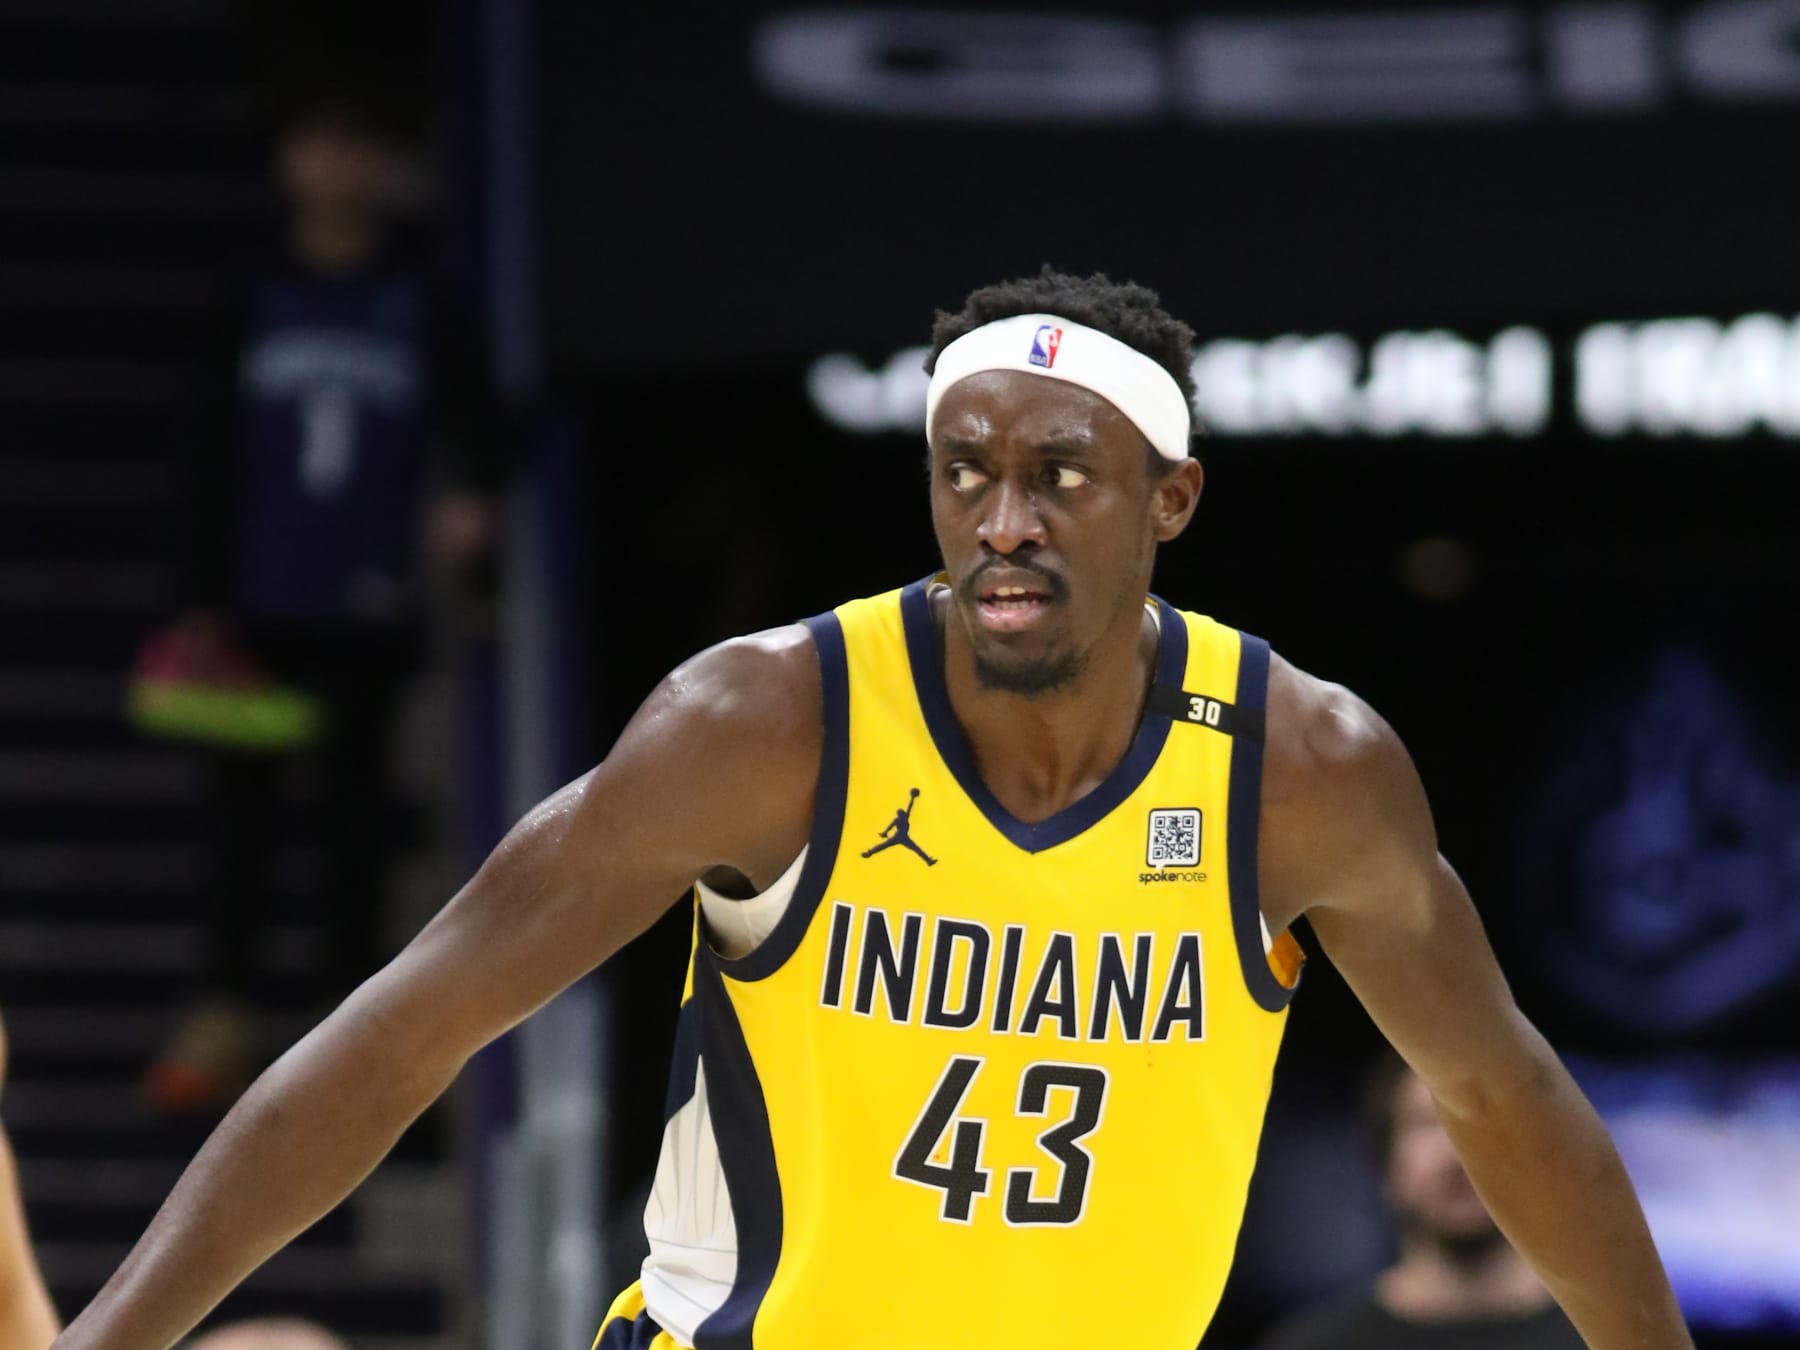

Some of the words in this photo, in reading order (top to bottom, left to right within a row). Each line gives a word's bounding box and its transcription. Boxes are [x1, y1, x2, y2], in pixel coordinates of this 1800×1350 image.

[1188, 697, 1221, 726] 30
[1139, 870, 1207, 885] spokenote
[819, 900, 1207, 1044] INDIANA
[891, 1053, 1111, 1228] 43
